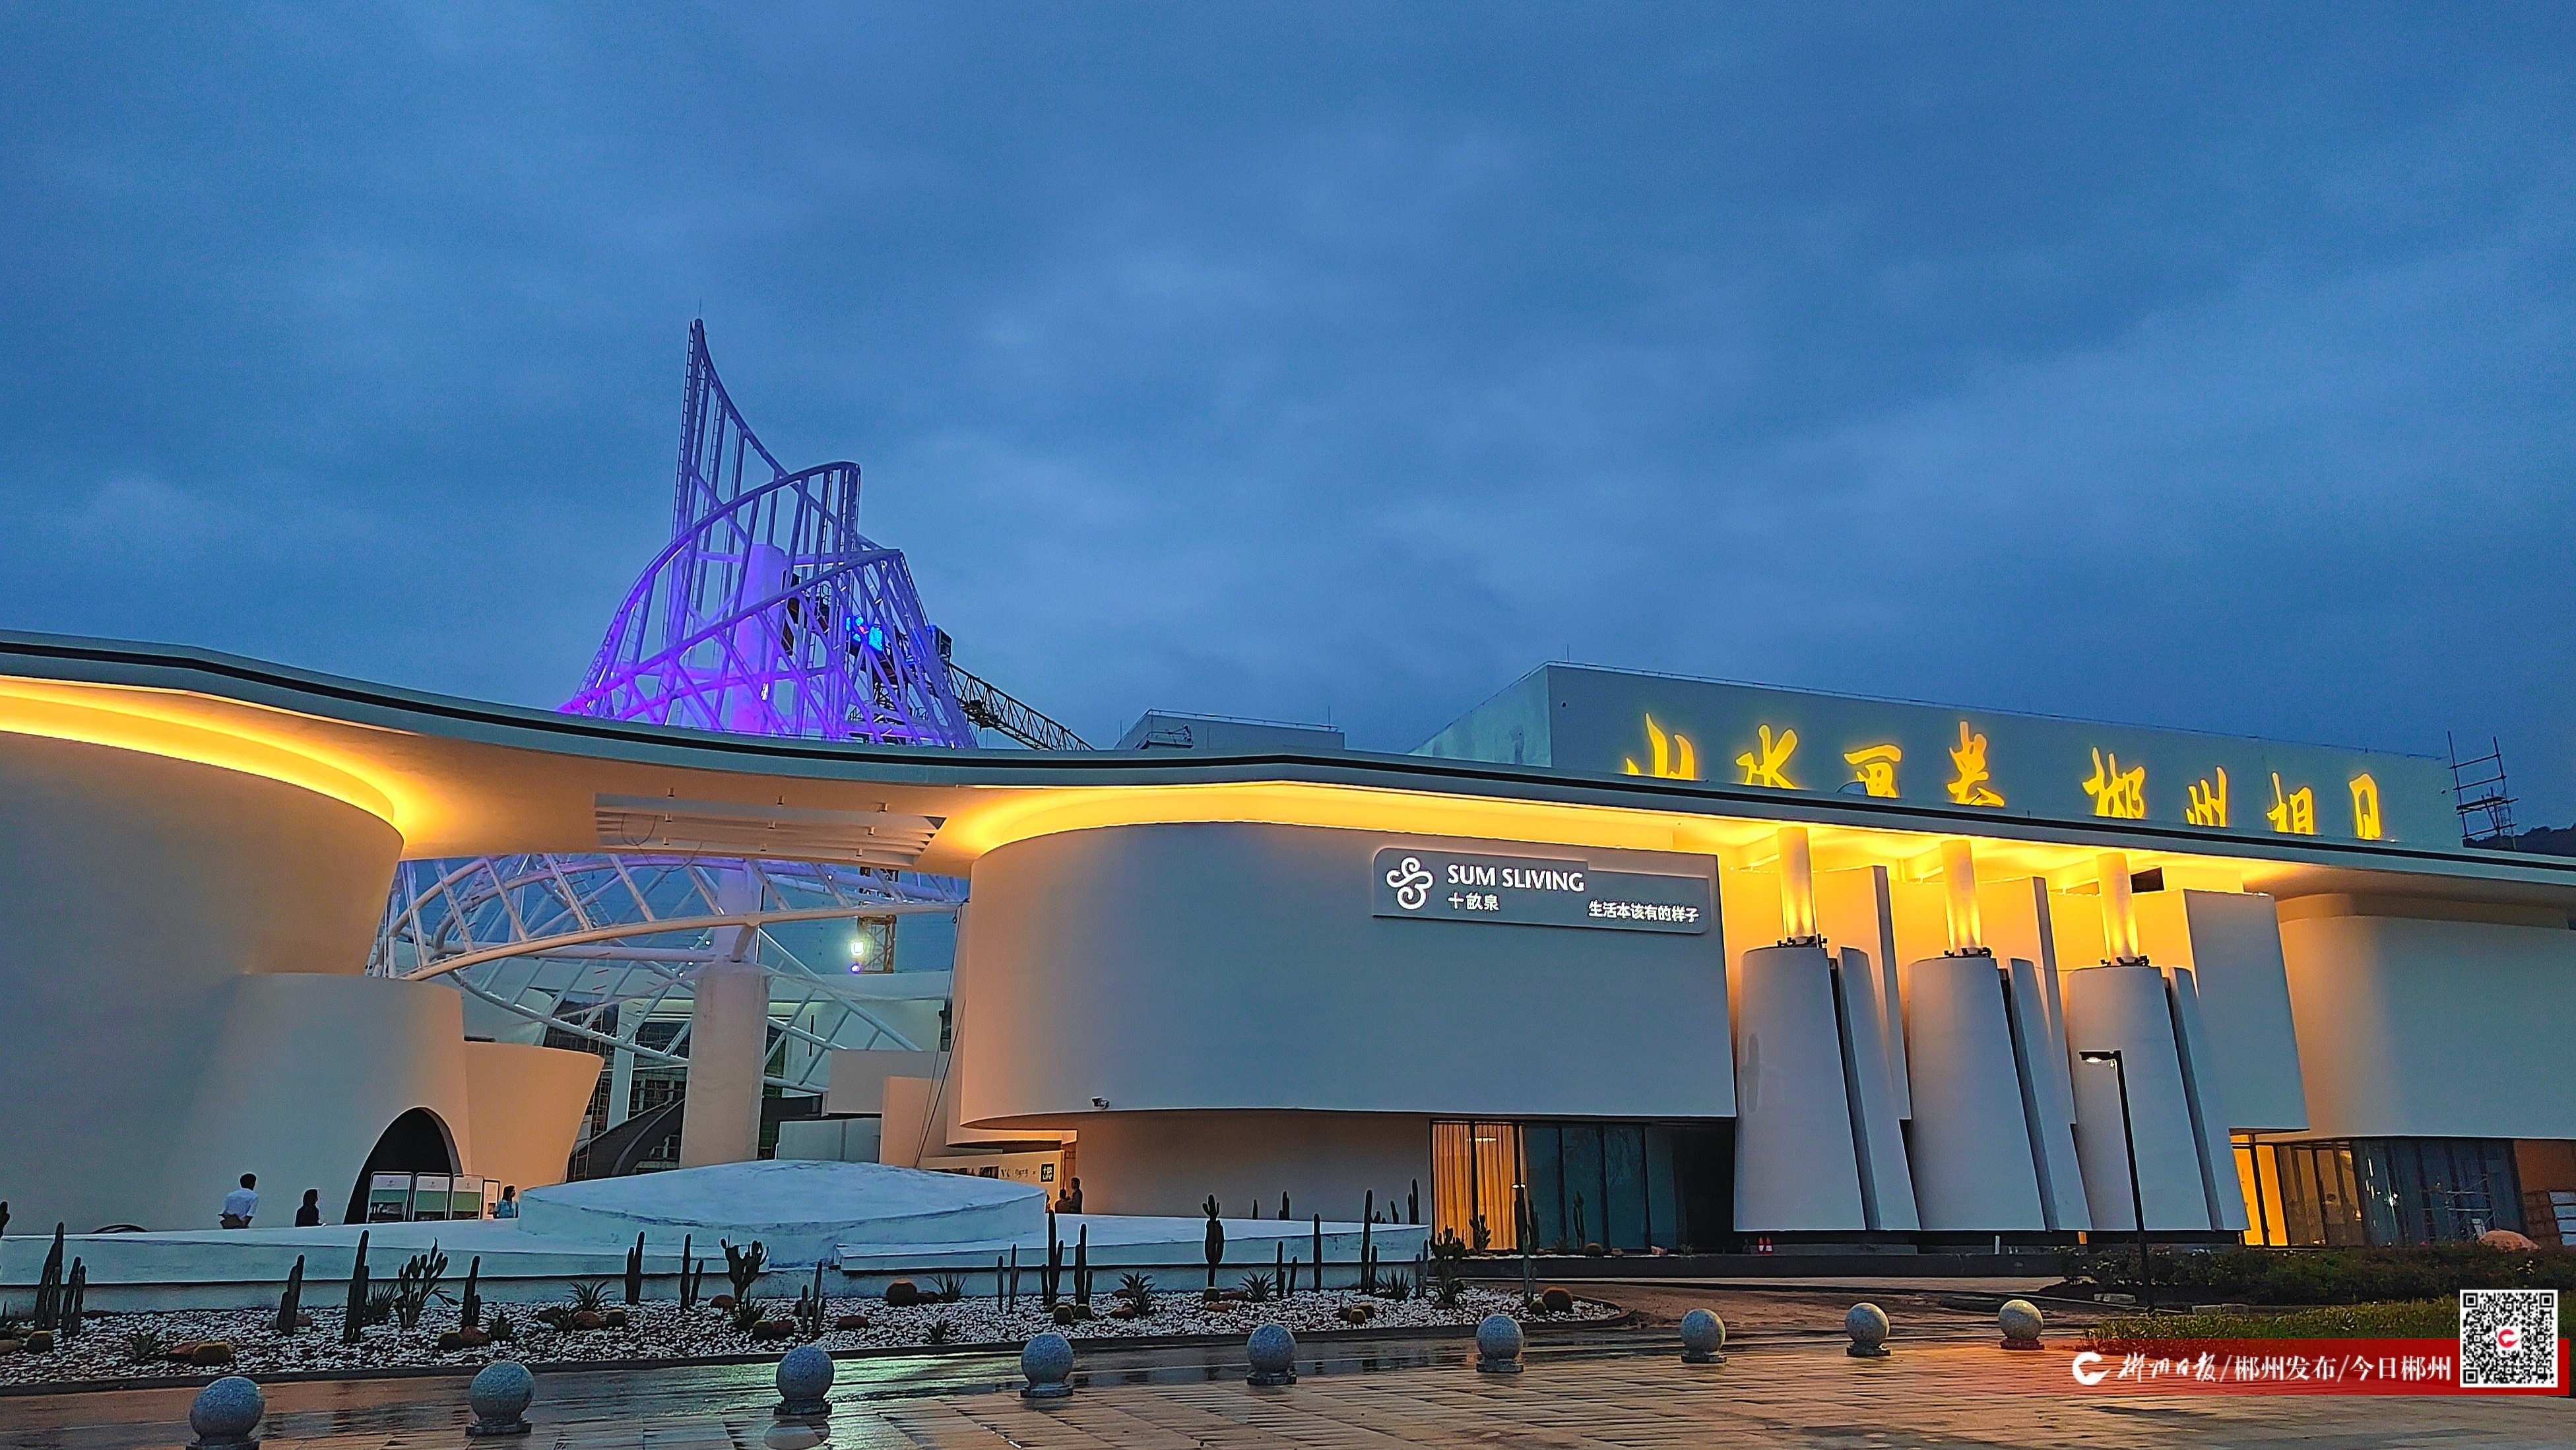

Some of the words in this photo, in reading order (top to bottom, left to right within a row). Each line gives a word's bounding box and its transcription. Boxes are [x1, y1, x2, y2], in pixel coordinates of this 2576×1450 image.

[1447, 865, 1496, 887] SUM
[1502, 868, 1585, 892] SLIVING
[1588, 900, 1699, 923] 生活本该有的样子
